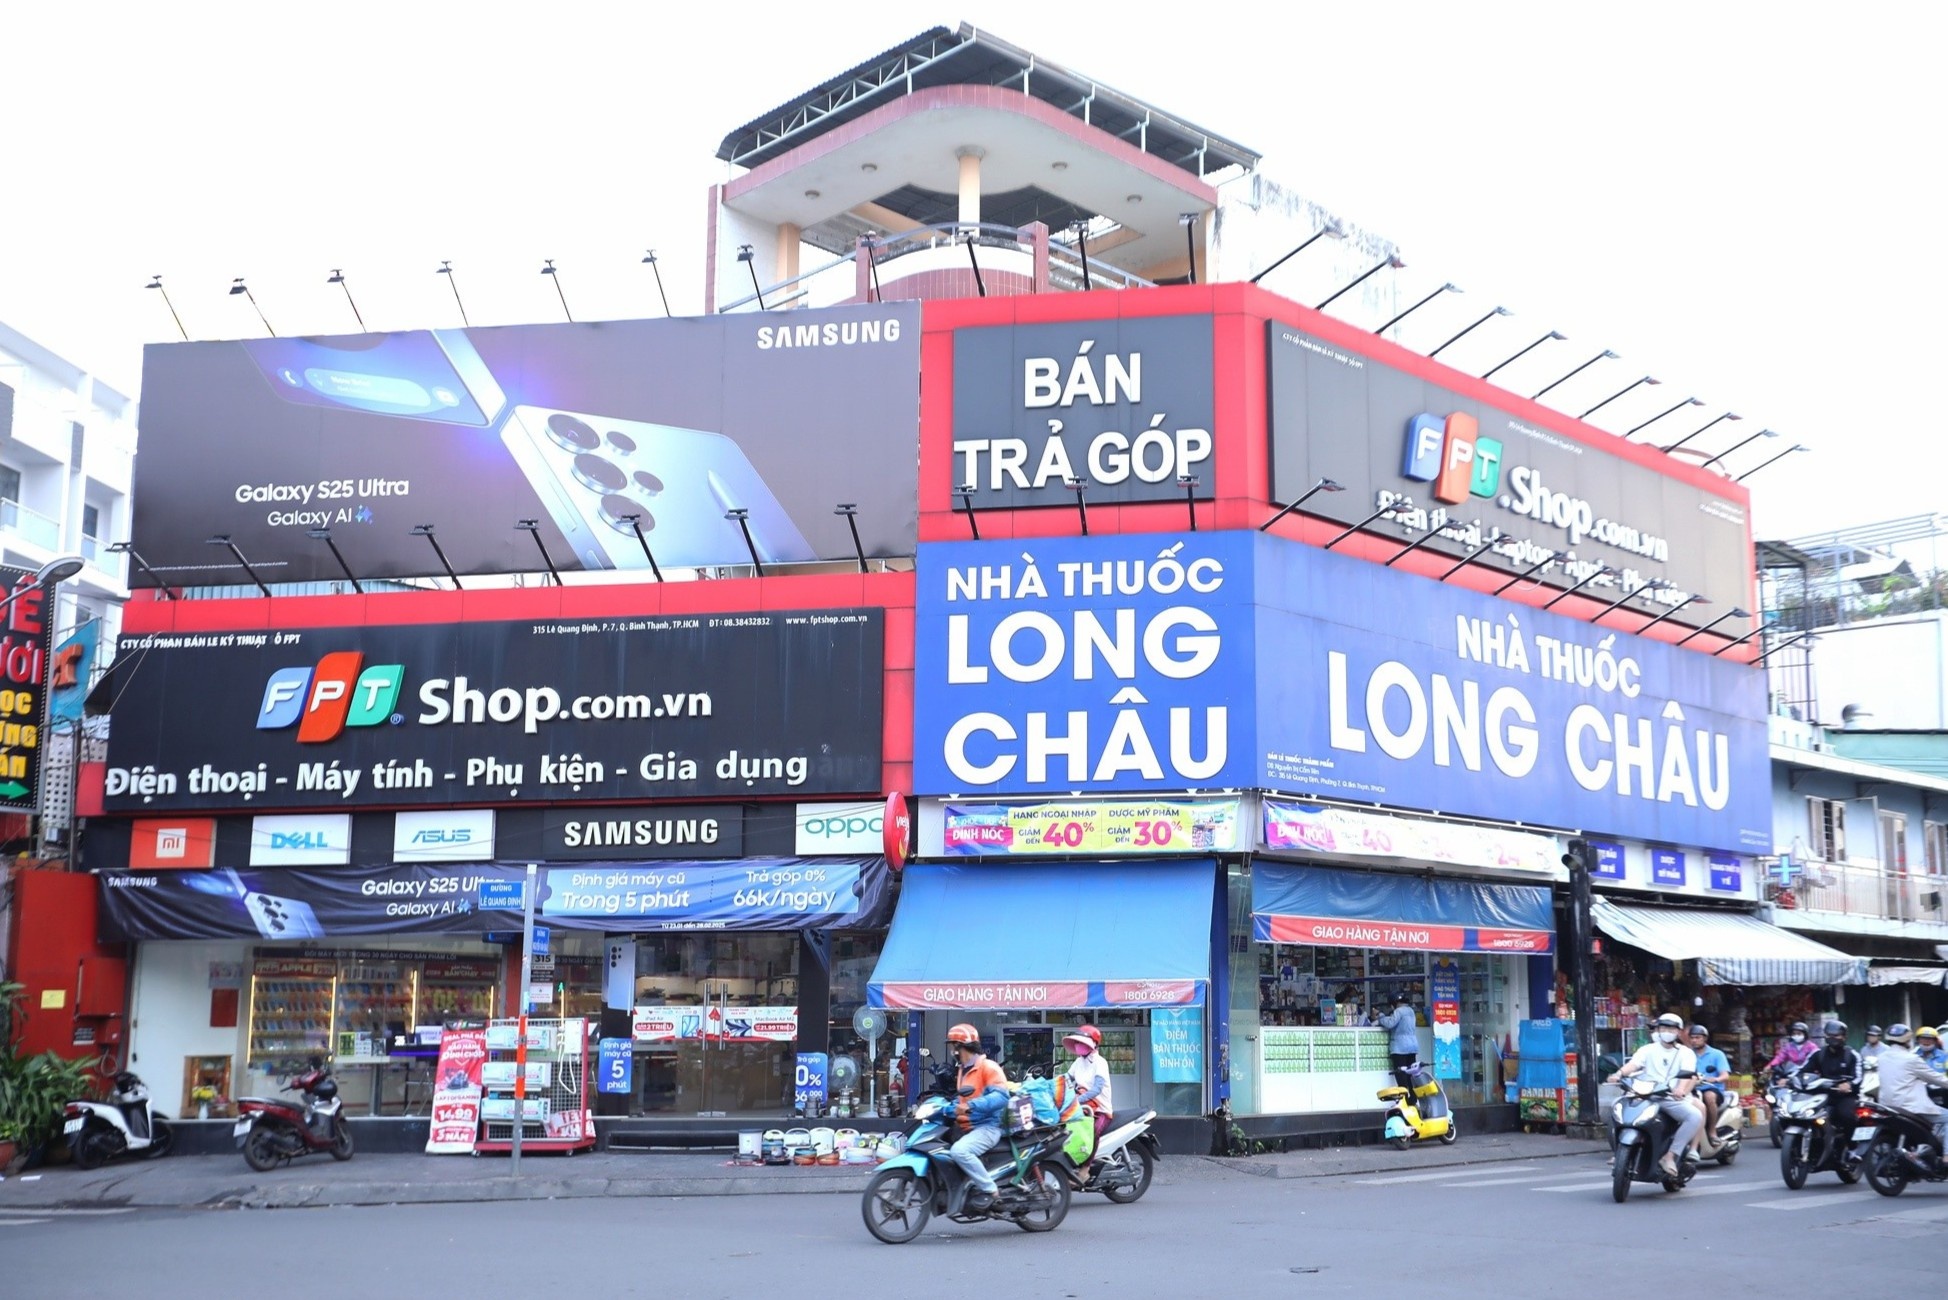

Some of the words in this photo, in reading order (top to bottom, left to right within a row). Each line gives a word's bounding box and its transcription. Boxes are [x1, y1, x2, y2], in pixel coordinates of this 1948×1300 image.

[757, 319, 900, 349] SAMSUNG
[1024, 340, 1142, 408] BÁN
[953, 420, 1077, 490] TRẢ
[1088, 414, 1213, 485] GÓP
[236, 481, 312, 505] Galaxy
[317, 479, 354, 498] S25
[358, 477, 409, 497] Ultra
[268, 510, 334, 529] Galaxy
[336, 507, 352, 524] AI
[947, 552, 1048, 601] NHÀ
[1057, 541, 1224, 597] THUỐC
[533, 626, 546, 634] 315
[557, 624, 580, 635] Quang
[673, 619, 699, 629] TP.HCM
[120, 639, 140, 650] CTY
[184, 634, 206, 648] BÁN
[284, 634, 300, 644] FPT
[947, 606, 1222, 684] LONG
[1456, 614, 1530, 674] NHÀ
[1536, 633, 1642, 699] THUỐC
[418, 676, 712, 734] Shop.com.vn
[943, 686, 1228, 785] CHÂU
[1327, 651, 1540, 778] LONG
[1565, 700, 1731, 811] CHÂU
[105, 763, 176, 803] Điện
[188, 763, 267, 800] thoại
[296, 760, 362, 798] Máy
[372, 759, 434, 790] tính
[467, 756, 523, 797] Phụ
[540, 754, 604, 792] kiện
[640, 751, 698, 781] Gia
[716, 750, 808, 788] dụng
[271, 832, 328, 850] DELL
[411, 829, 472, 844] ASUS
[564, 818, 719, 847] SAMSUNG
[1043, 821, 1095, 848] 40%
[1134, 820, 1183, 846] 30%
[108, 876, 158, 888] SAMSUNG
[361, 880, 424, 899] Galaxy
[428, 877, 459, 894] S25
[572, 872, 602, 888] Định
[605, 871, 628, 888] giá
[632, 872, 666, 888] máy
[668, 870, 686, 884] cũ
[746, 869, 773, 883] Trả
[776, 868, 802, 886] góp
[804, 868, 826, 883] 0%
[386, 901, 437, 918] Galaxy
[440, 900, 456, 914] AI
[488, 897, 507, 907] QUANG
[562, 891, 621, 914] Trong
[624, 892, 636, 909] 5
[640, 888, 690, 912] phút
[733, 886, 836, 910] 66k/ngày
[1312, 926, 1344, 940] GIAO
[1345, 925, 1379, 942] HÀNG
[1381, 927, 1404, 946] TẬN
[1406, 929, 1430, 944] NƠI
[280, 963, 312, 973] APPLE
[534, 954, 552, 963] 315
[924, 986, 956, 1002] GIAO
[958, 984, 995, 1002] HÀNG
[996, 984, 1022, 1006] TẬN
[1024, 984, 1048, 1001] NƠI
[1124, 991, 1148, 1000] 1800
[1150, 990, 1174, 1000] 6928
[604, 1042, 618, 1050] Định
[620, 1041, 632, 1050] giá
[611, 1060, 625, 1080] 5
[808, 1056, 820, 1064] góp
[607, 1080, 628, 1092] phút
[796, 1064, 822, 1086] 0%
